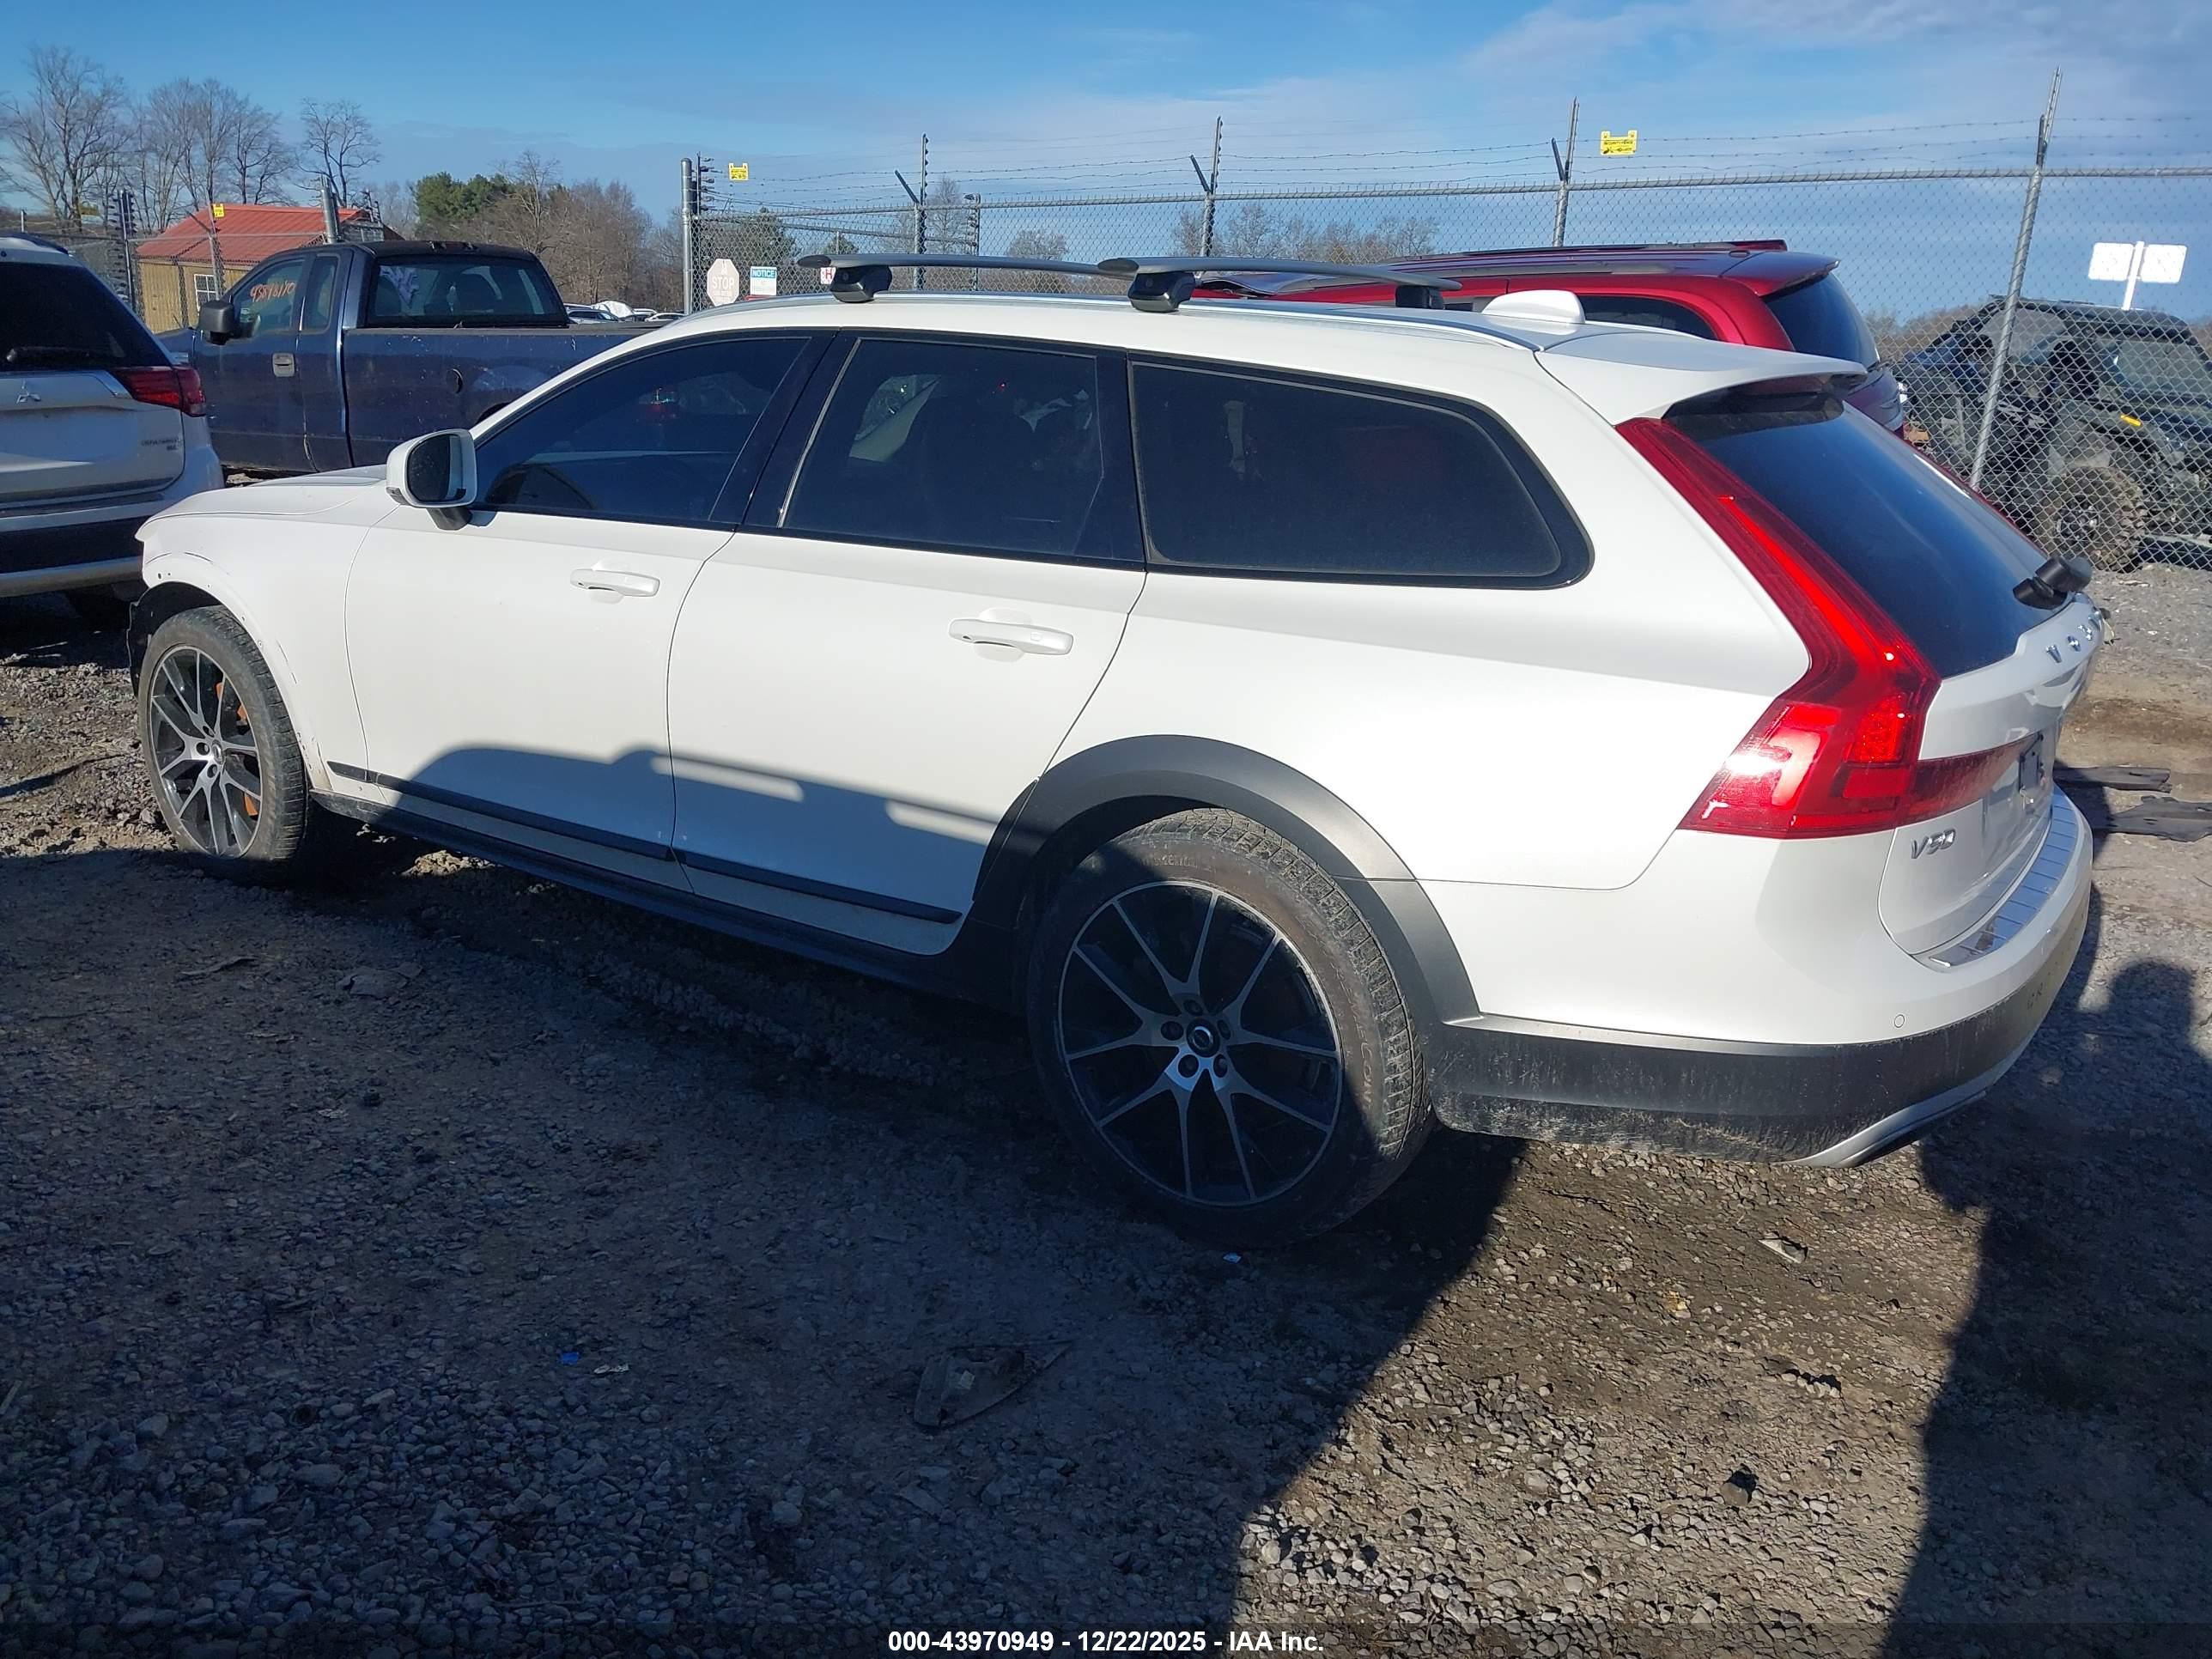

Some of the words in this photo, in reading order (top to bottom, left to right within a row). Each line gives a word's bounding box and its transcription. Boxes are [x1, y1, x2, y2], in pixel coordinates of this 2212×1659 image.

[751, 269, 775, 278] NOTICE
[712, 276, 735, 289] STOP
[1911, 828, 1956, 860] V90
